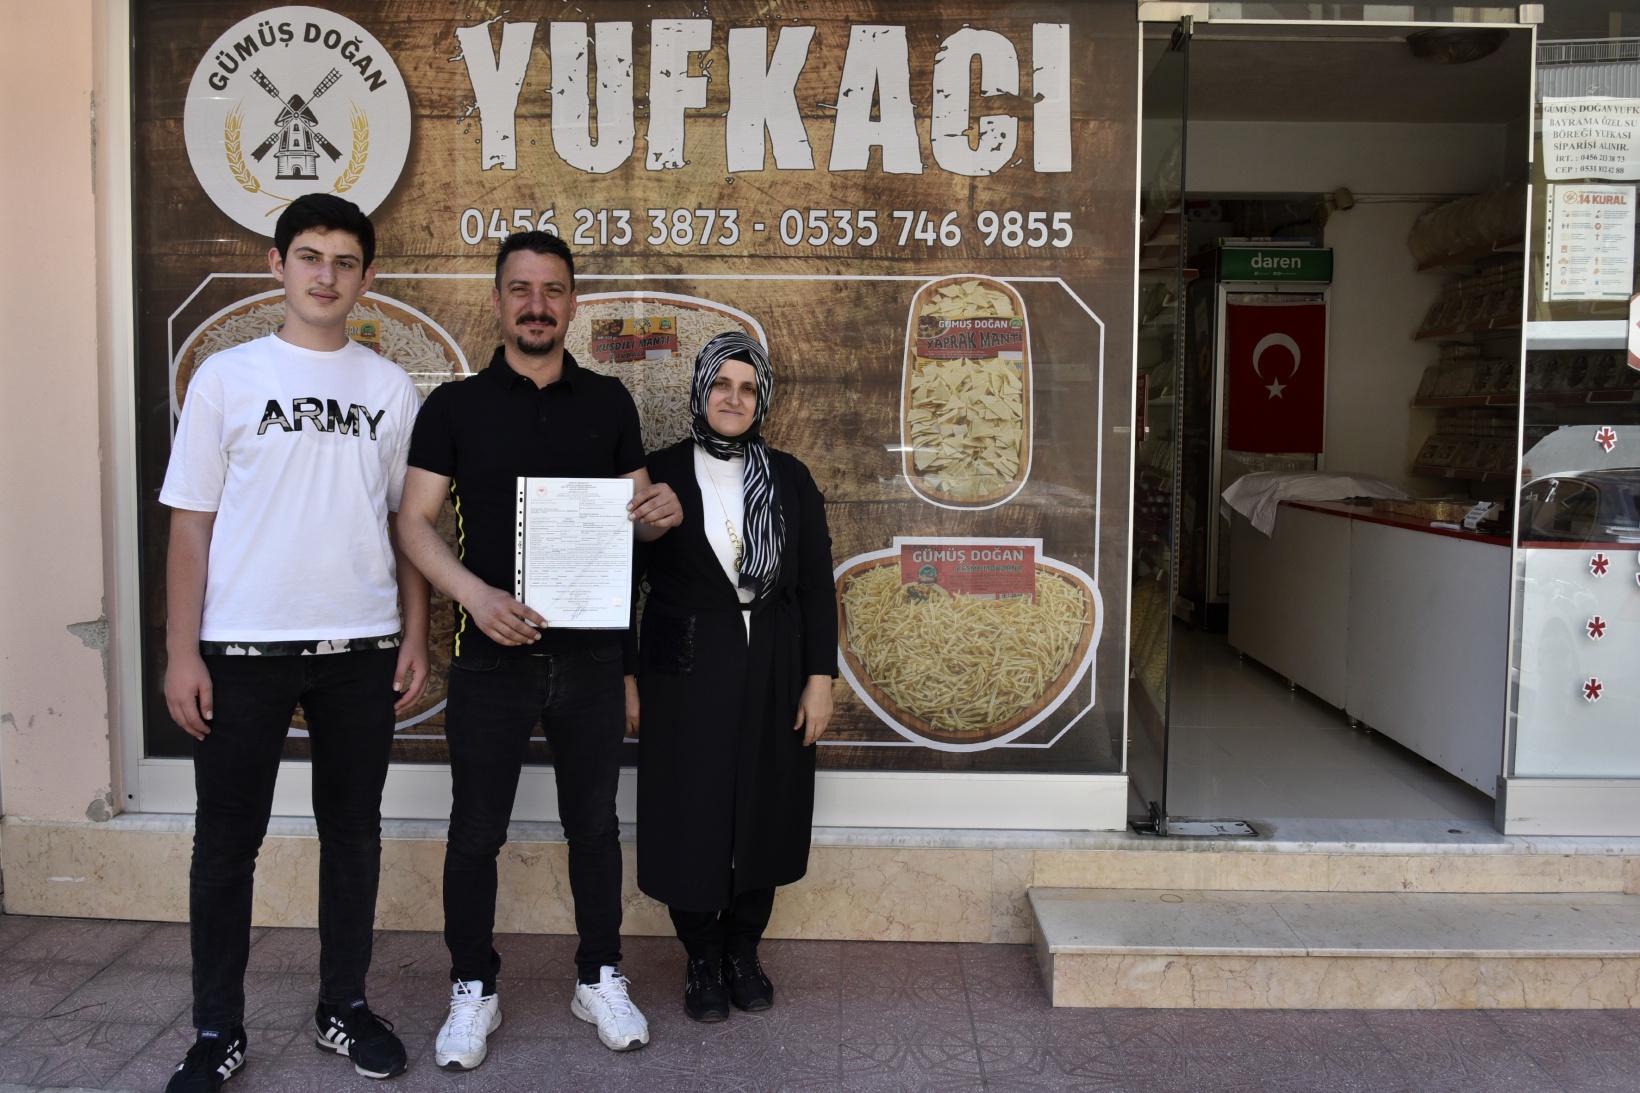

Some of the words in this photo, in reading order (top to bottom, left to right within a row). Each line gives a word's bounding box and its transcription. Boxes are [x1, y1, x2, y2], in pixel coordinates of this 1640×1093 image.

[208, 20, 294, 91] GÜMÜŞ
[303, 22, 388, 93] DOĞAN
[454, 18, 1073, 177] YUFKACI
[1544, 104, 1577, 115] GÜMÜŞ
[1579, 103, 1612, 114] DOĞAN
[1549, 117, 1599, 127] BAYRAMA
[1601, 116, 1622, 127] ÖZEL
[1624, 119, 1638, 128] SU
[1553, 128, 1592, 139] BÖREĞİ
[1595, 129, 1632, 140] YUFKASI
[1553, 139, 1597, 151] SİPARİŞİ
[1599, 142, 1629, 152] ALINIR.
[1556, 154, 1573, 162] İRT.
[1580, 153, 1598, 161] 0456
[1555, 166, 1573, 174] CEP
[1580, 165, 1597, 173] 0531
[1579, 194, 1591, 205] 14
[1592, 194, 1627, 206] KURAL
[460, 207, 560, 246] 0456
[573, 207, 634, 246] 213
[646, 209, 741, 247] 3873
[778, 210, 879, 248] 0535
[893, 210, 963, 248] 746
[976, 210, 1074, 249] 9855
[1250, 252, 1302, 269] daren
[938, 317, 972, 329] GÜMÜŞ
[974, 318, 1008, 329] DOĞAN
[927, 331, 977, 349] YAPRAK
[257, 397, 386, 441] ARMY
[912, 548, 966, 563] GÜMÜŞ
[970, 547, 1025, 562] DOĞAN
